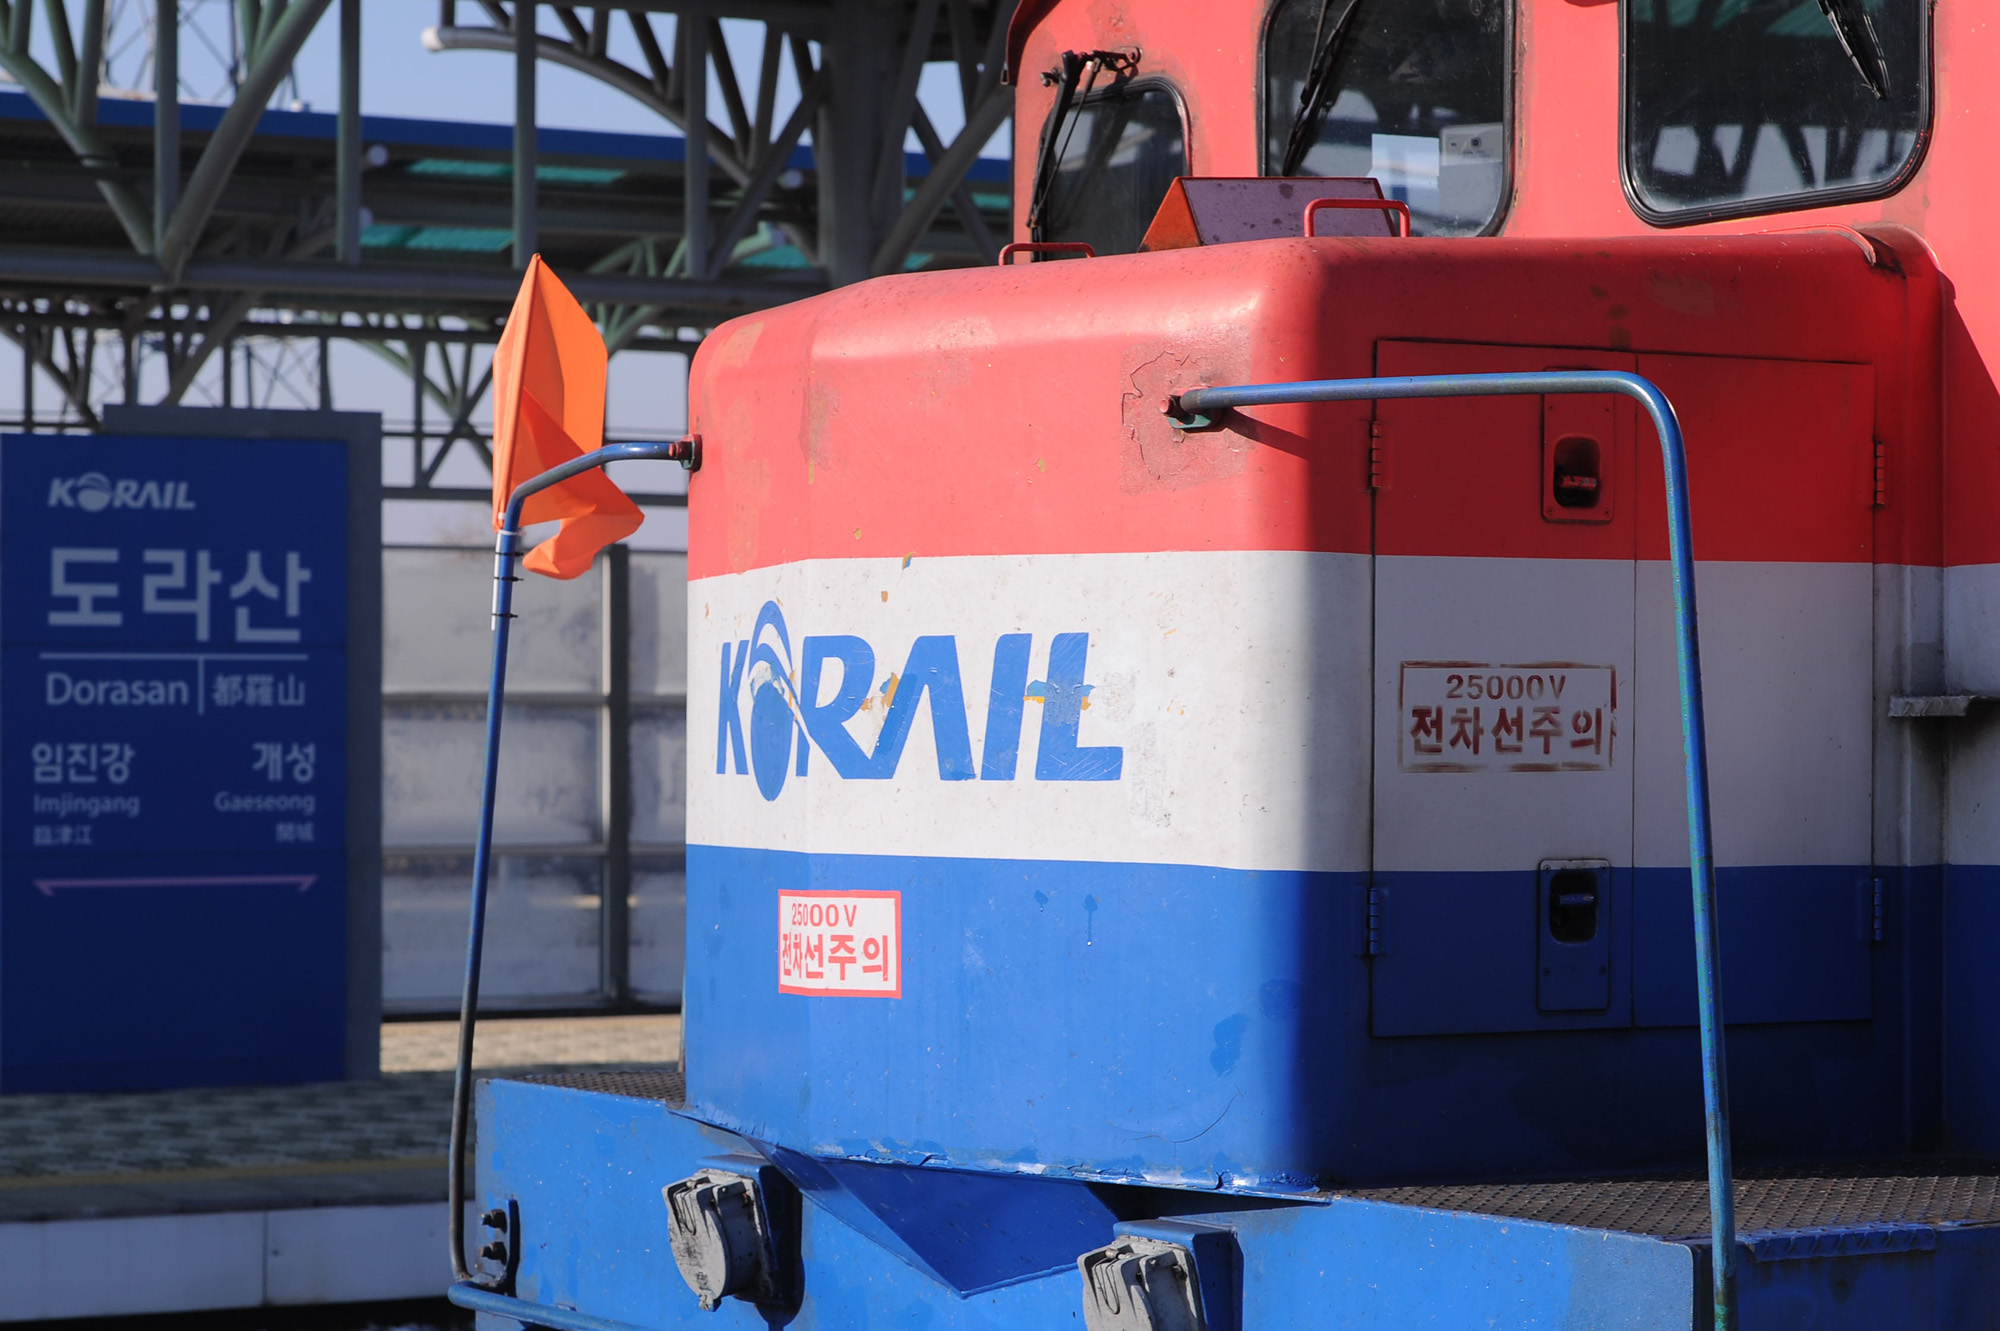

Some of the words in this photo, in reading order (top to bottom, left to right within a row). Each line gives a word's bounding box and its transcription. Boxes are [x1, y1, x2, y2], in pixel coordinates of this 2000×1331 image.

[48, 472, 196, 512] KORAIL
[48, 547, 312, 642] 도라산
[46, 672, 190, 706] Dorasan
[716, 600, 1124, 802] KORAIL
[1410, 705, 1603, 756] 전차선주의
[31, 742, 136, 784] 임진강
[251, 742, 316, 782] 개성
[33, 794, 140, 817] Imjingang
[214, 791, 316, 815] Gaeseong
[782, 932, 889, 982] 전차선주의
